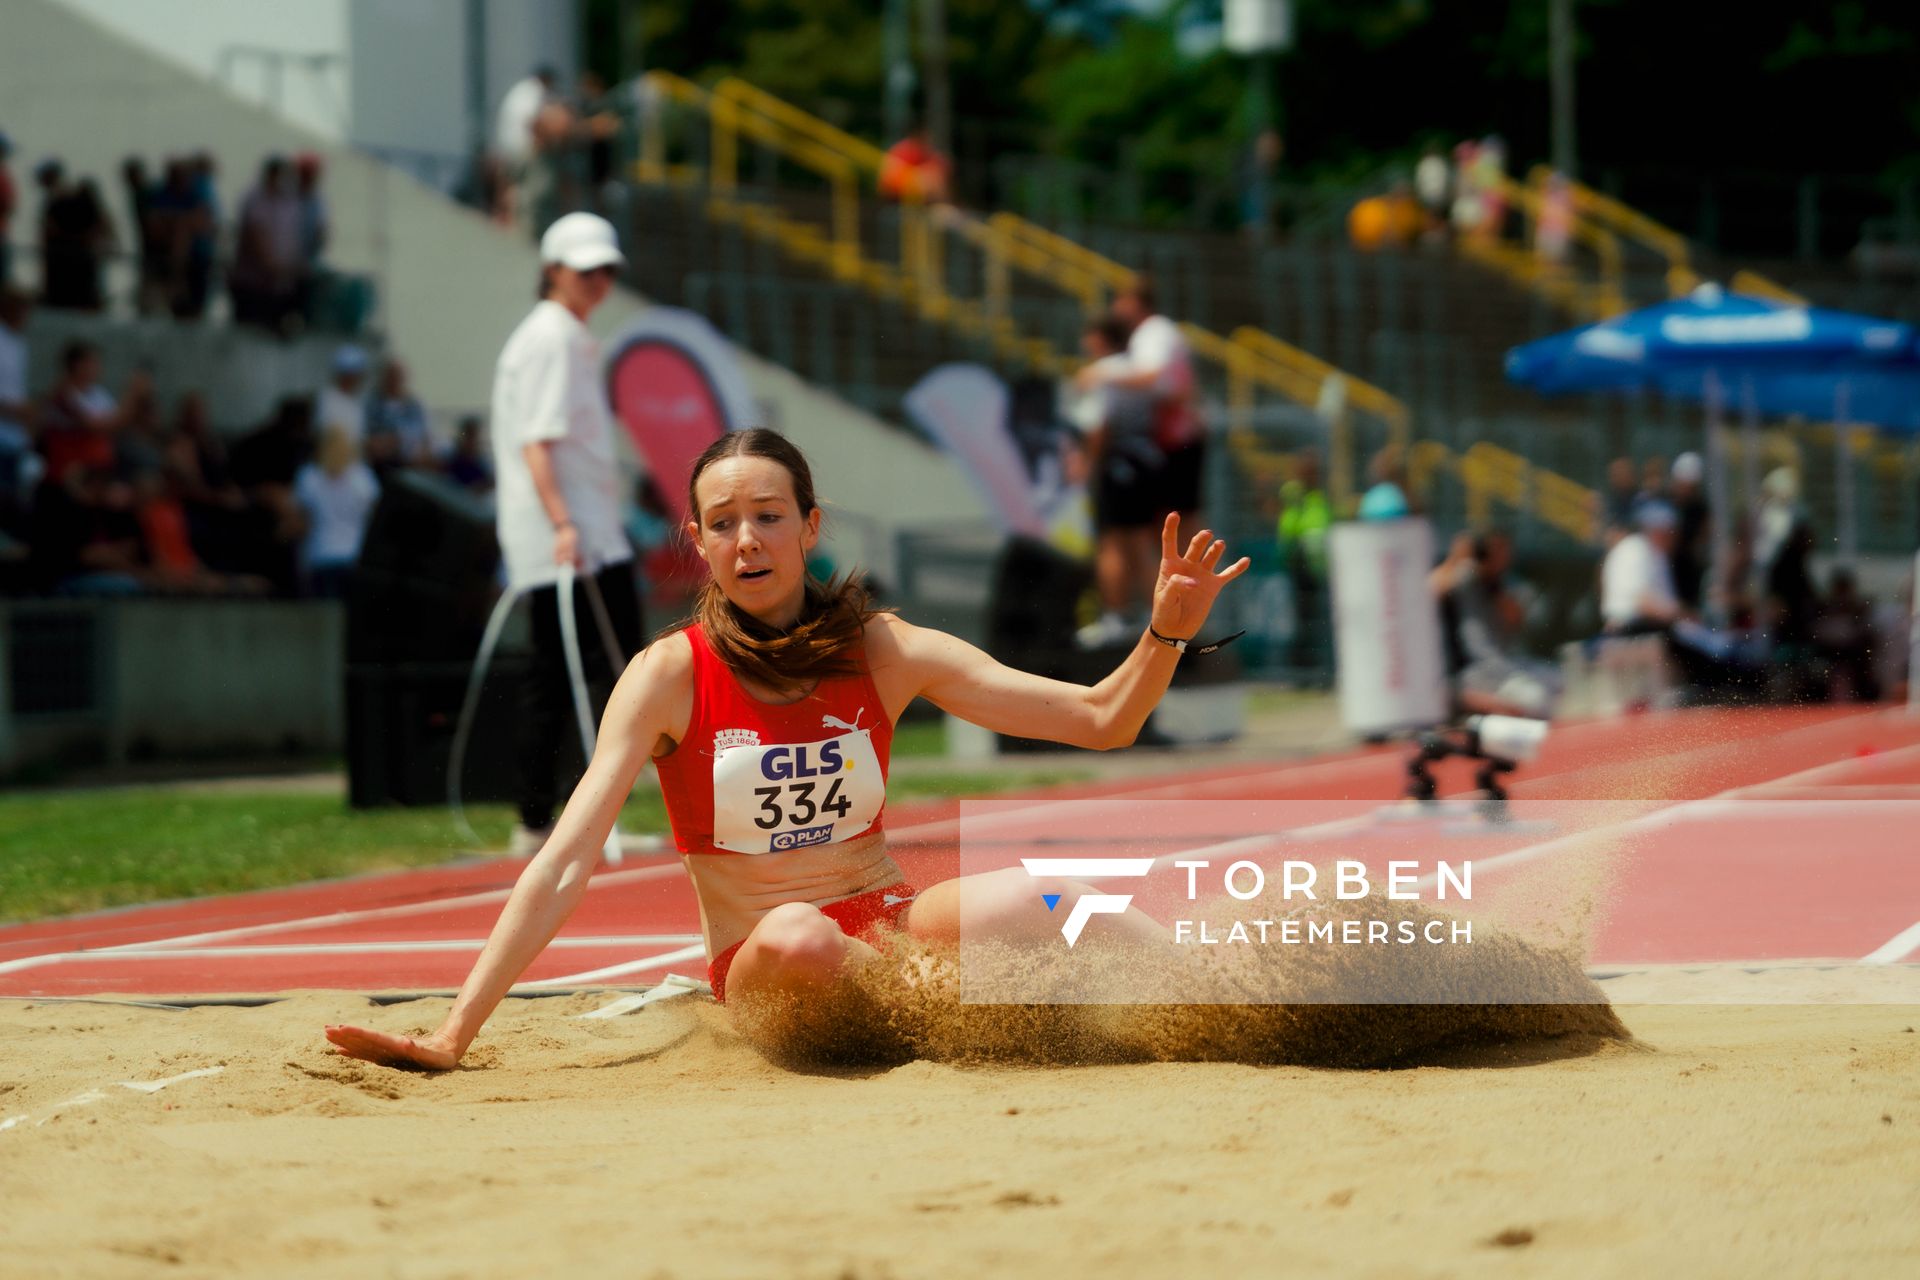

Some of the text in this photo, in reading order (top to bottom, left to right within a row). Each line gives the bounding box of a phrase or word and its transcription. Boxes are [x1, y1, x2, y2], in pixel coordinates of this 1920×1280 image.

[736, 737, 756, 746] 1860
[754, 778, 852, 829] 334
[797, 828, 831, 842] PLAN
